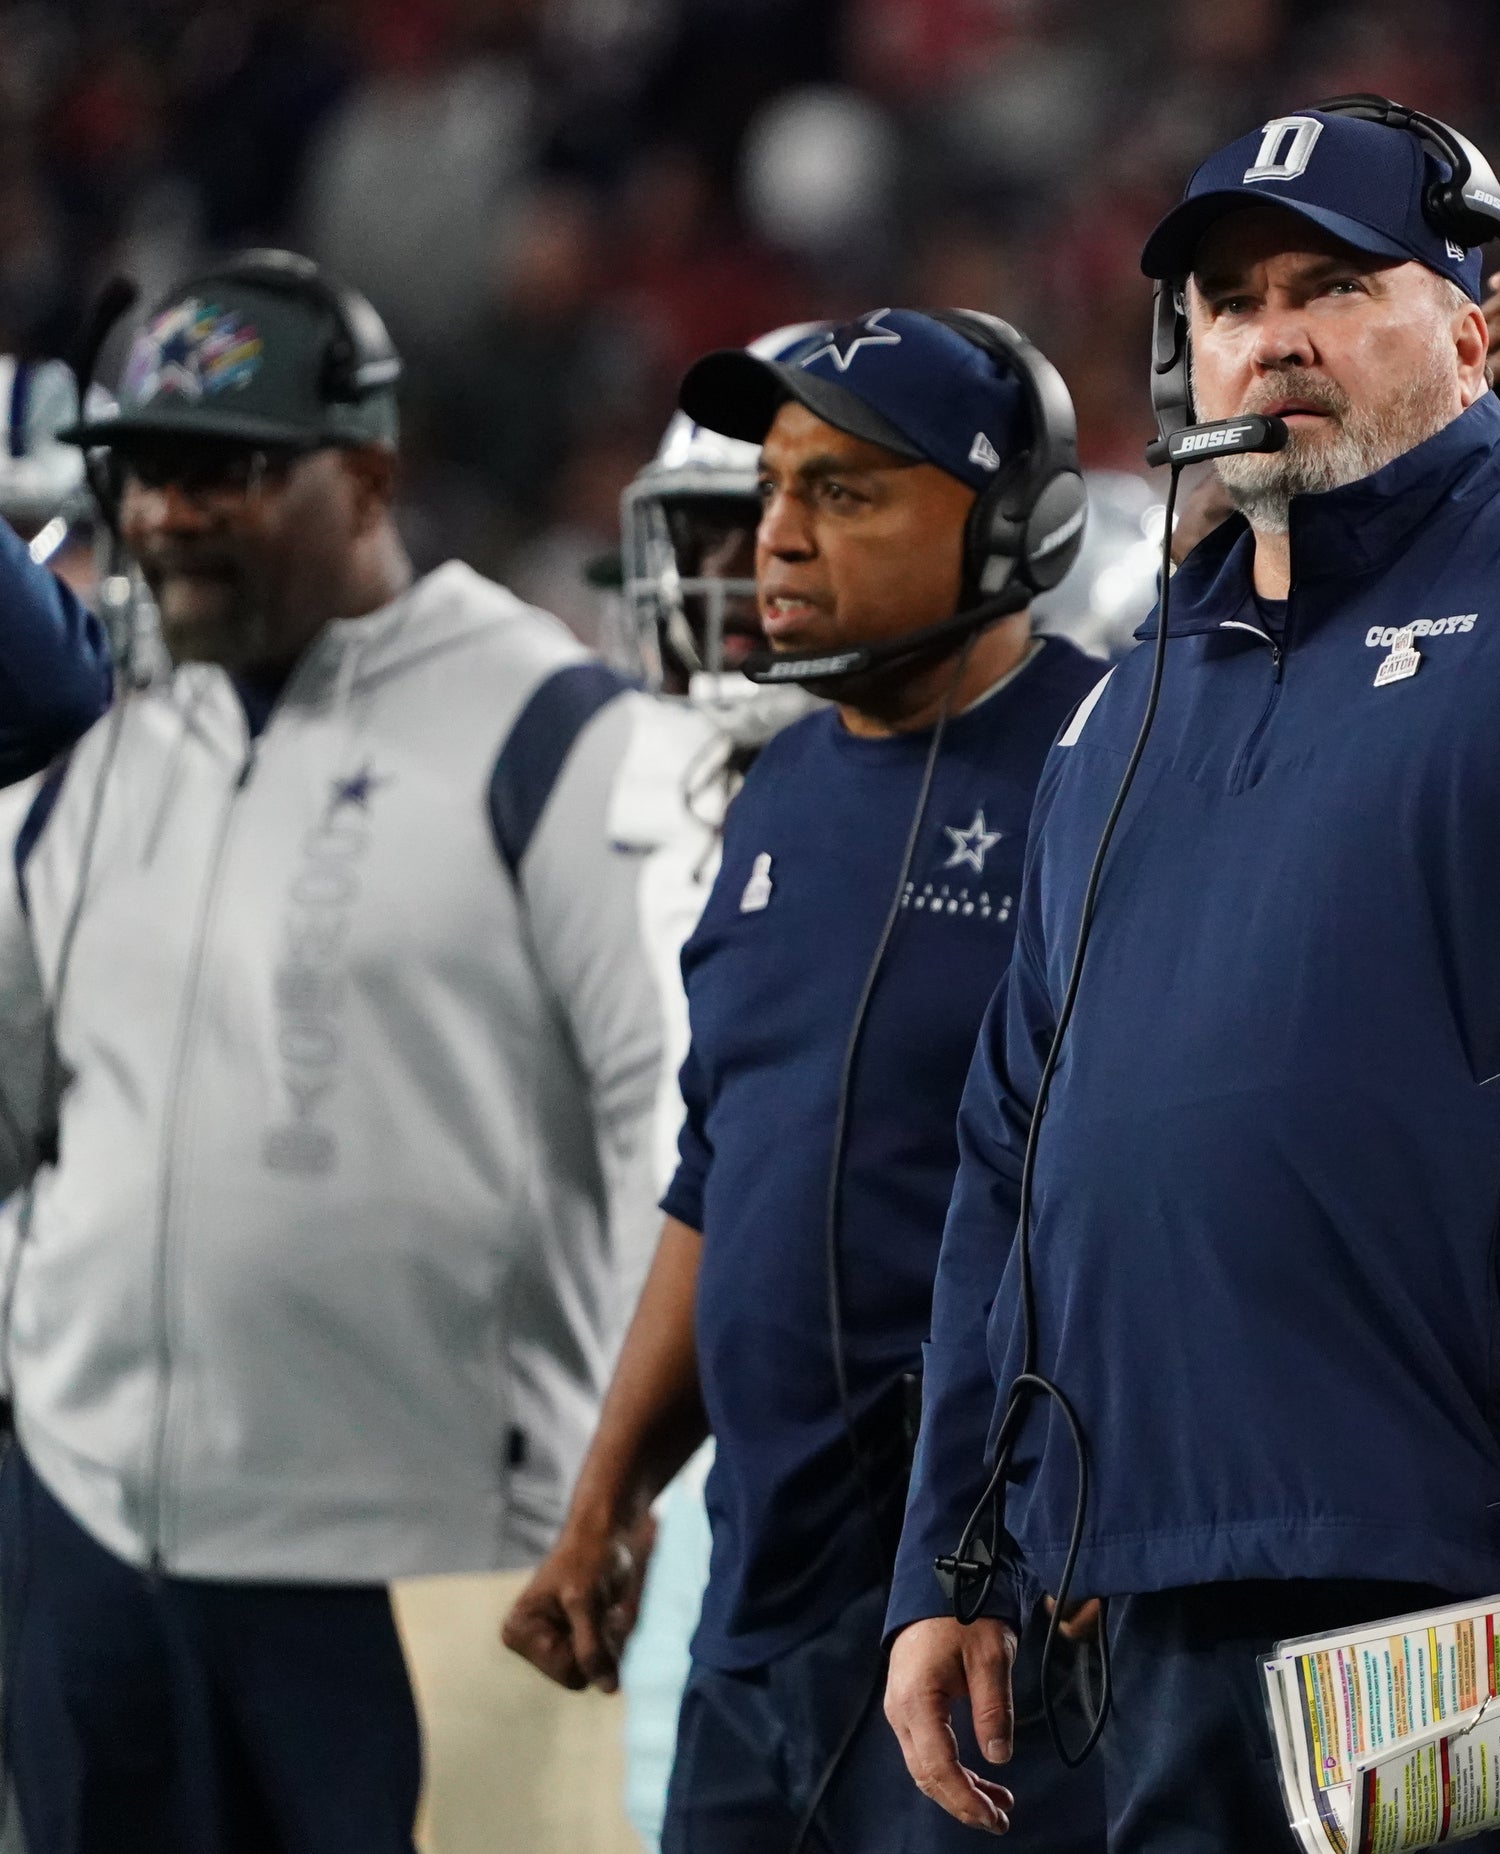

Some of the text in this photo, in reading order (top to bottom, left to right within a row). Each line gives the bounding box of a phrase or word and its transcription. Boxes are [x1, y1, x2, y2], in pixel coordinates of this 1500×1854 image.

[1243, 116, 1324, 184] D
[1173, 425, 1252, 455] BOSE
[1365, 613, 1479, 647] COBOYS
[1379, 655, 1416, 677] CATCH
